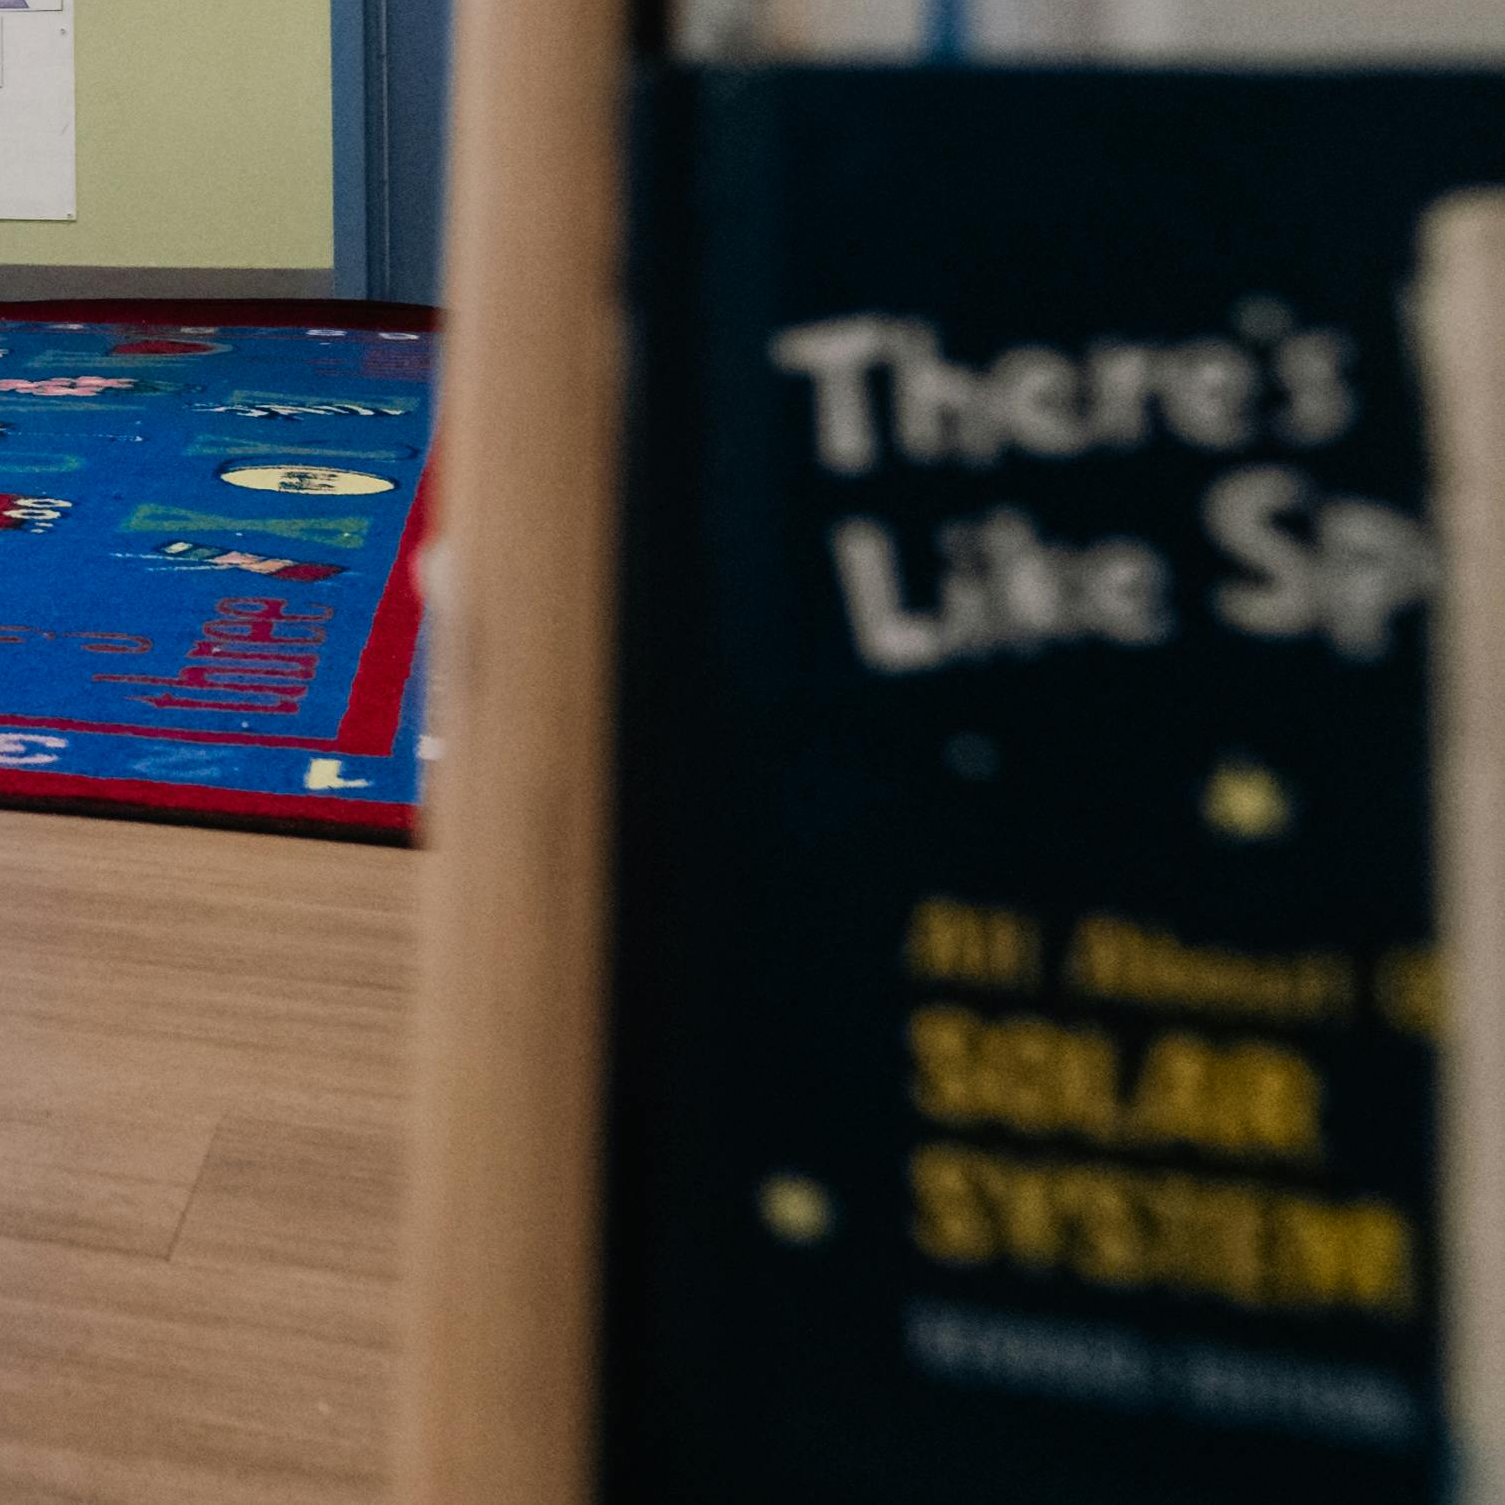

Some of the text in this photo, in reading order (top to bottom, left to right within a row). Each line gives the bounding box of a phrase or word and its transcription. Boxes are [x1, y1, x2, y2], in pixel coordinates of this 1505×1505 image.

[771, 295, 1356, 475] There's
[92, 596, 334, 714] three
[832, 503, 1175, 671] Like
